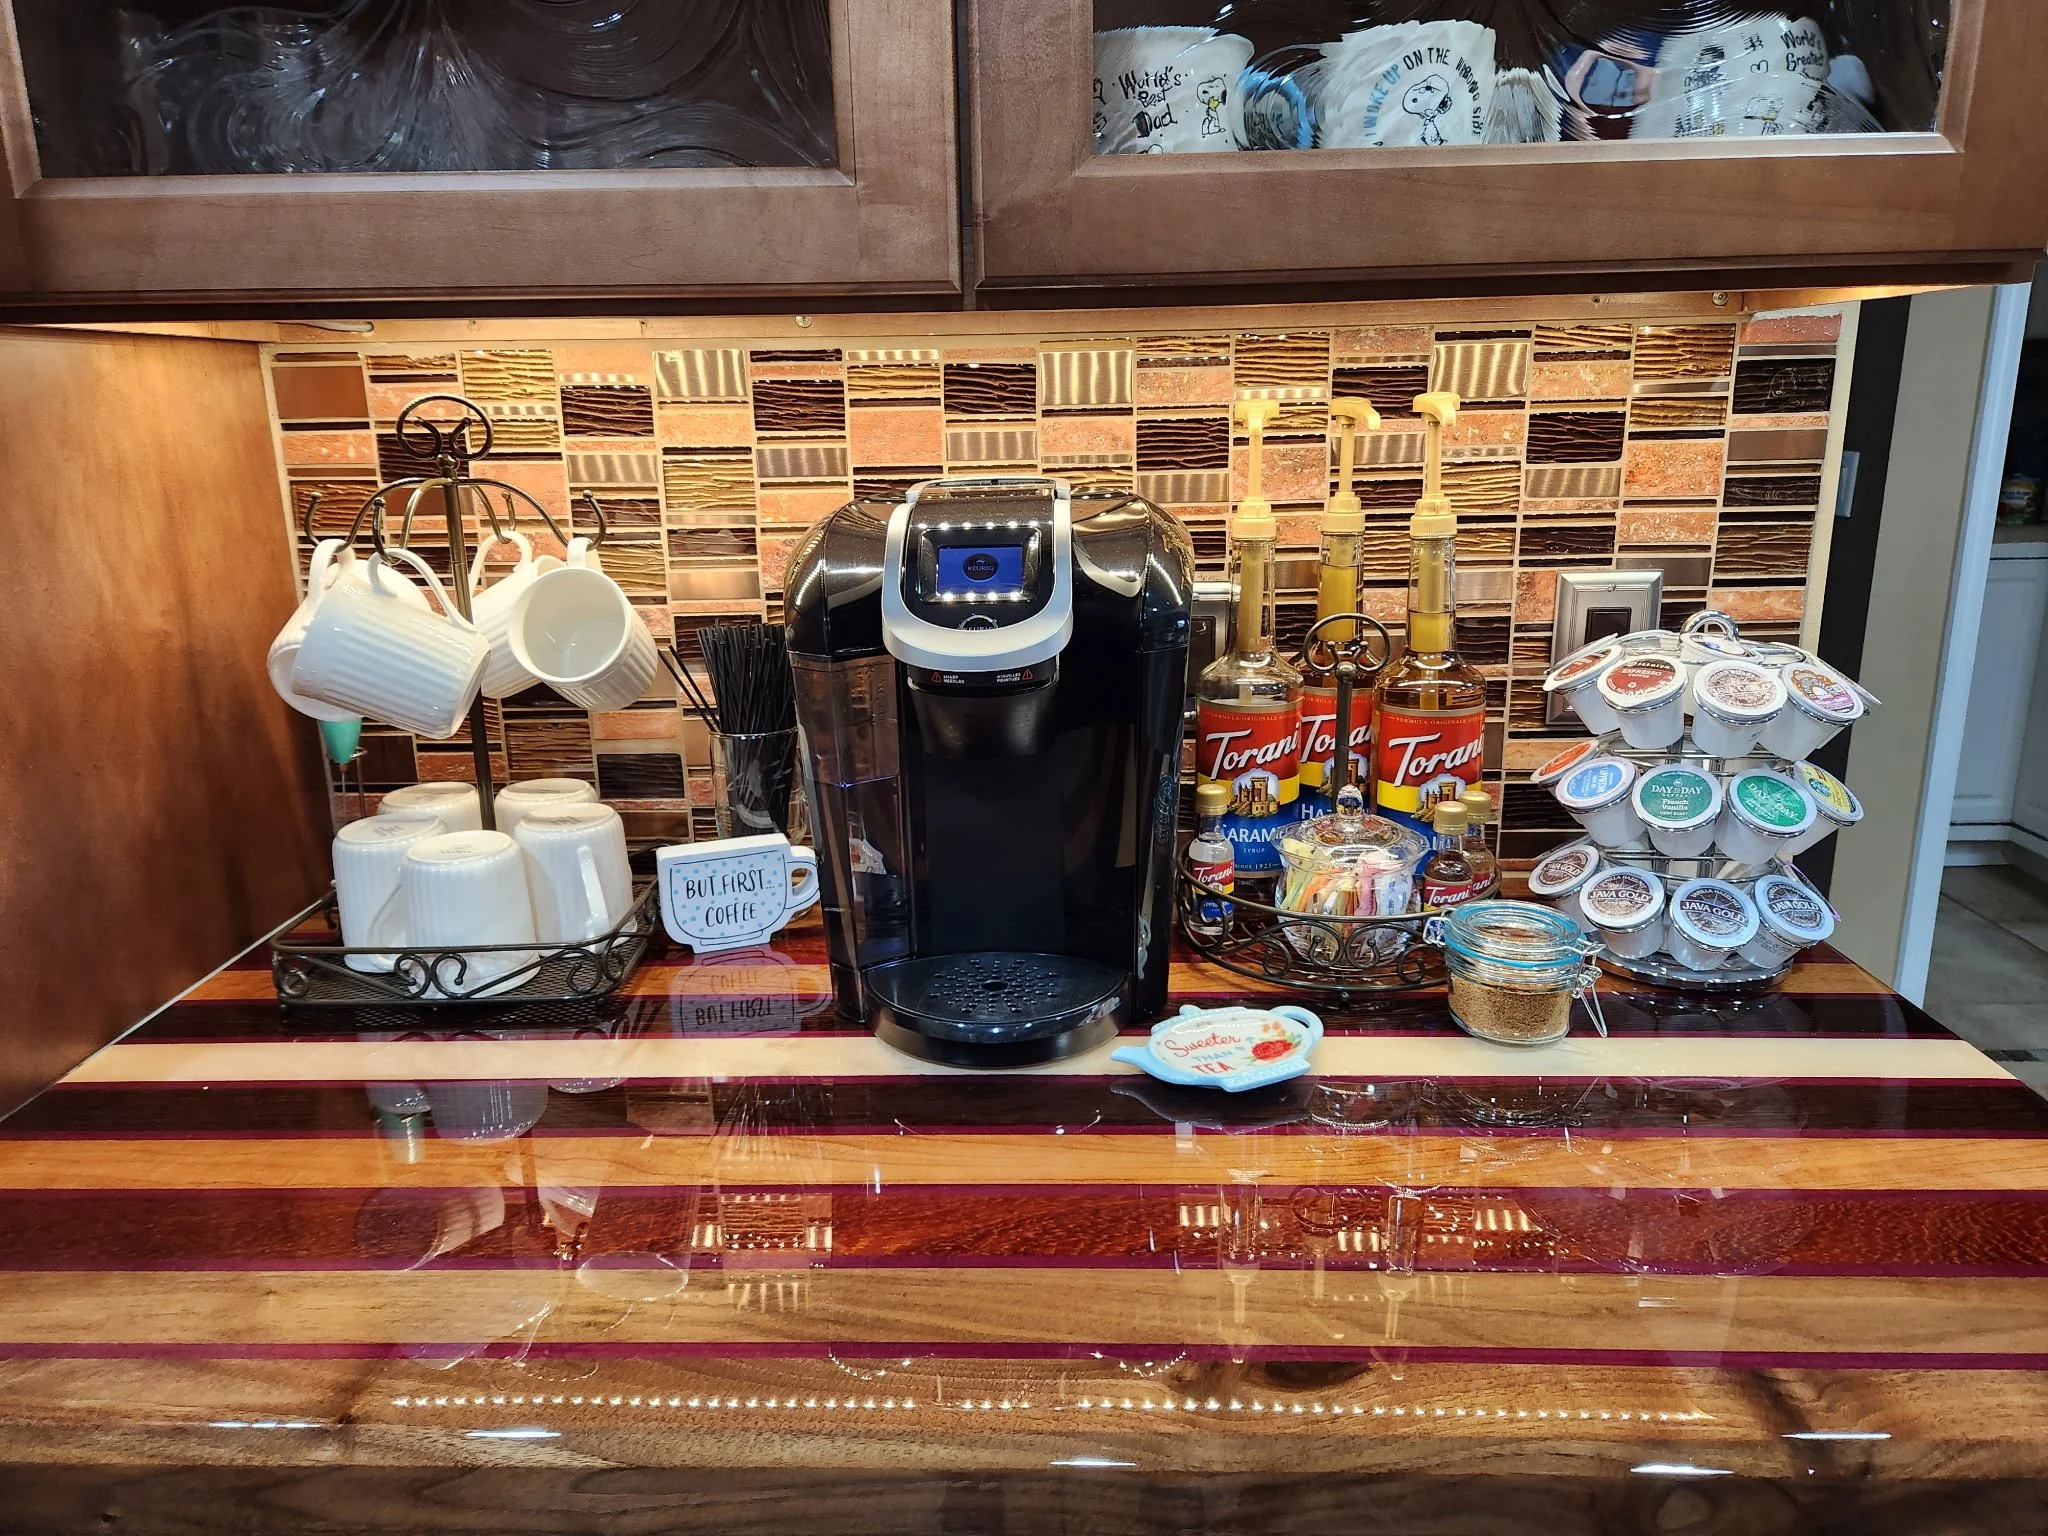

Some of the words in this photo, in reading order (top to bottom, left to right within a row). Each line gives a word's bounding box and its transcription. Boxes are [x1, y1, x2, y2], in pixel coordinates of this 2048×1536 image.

[1138, 86, 1173, 109] Best
[1363, 83, 1388, 129] WOKE
[1382, 63, 1401, 85] UP
[1403, 49, 1423, 71] ON
[1427, 47, 1451, 65] THE
[1131, 103, 1178, 138] Dad
[967, 564, 994, 572] KEURIG
[1205, 721, 1300, 781] Torani
[1388, 724, 1485, 787] Torani
[1652, 785, 1673, 794] DAY
[1748, 782, 1770, 799] DAY
[1194, 862, 1233, 882] Torani
[1561, 864, 1581, 876] GOLD
[686, 874, 717, 900] BUT
[1473, 876, 1493, 891] ani
[1426, 886, 1471, 906] Torani
[1590, 890, 1617, 899] JAVA
[1618, 890, 1650, 902] GOLD
[705, 902, 758, 928] COFFEE
[1682, 901, 1711, 912] JAVA
[1712, 907, 1746, 923] GOLD
[1771, 901, 1794, 912] JAVA
[1793, 901, 1820, 911] GOLD
[1165, 1032, 1241, 1058] Sweeter
[1192, 1050, 1234, 1063] THAN
[1191, 1062, 1236, 1075] TEA
